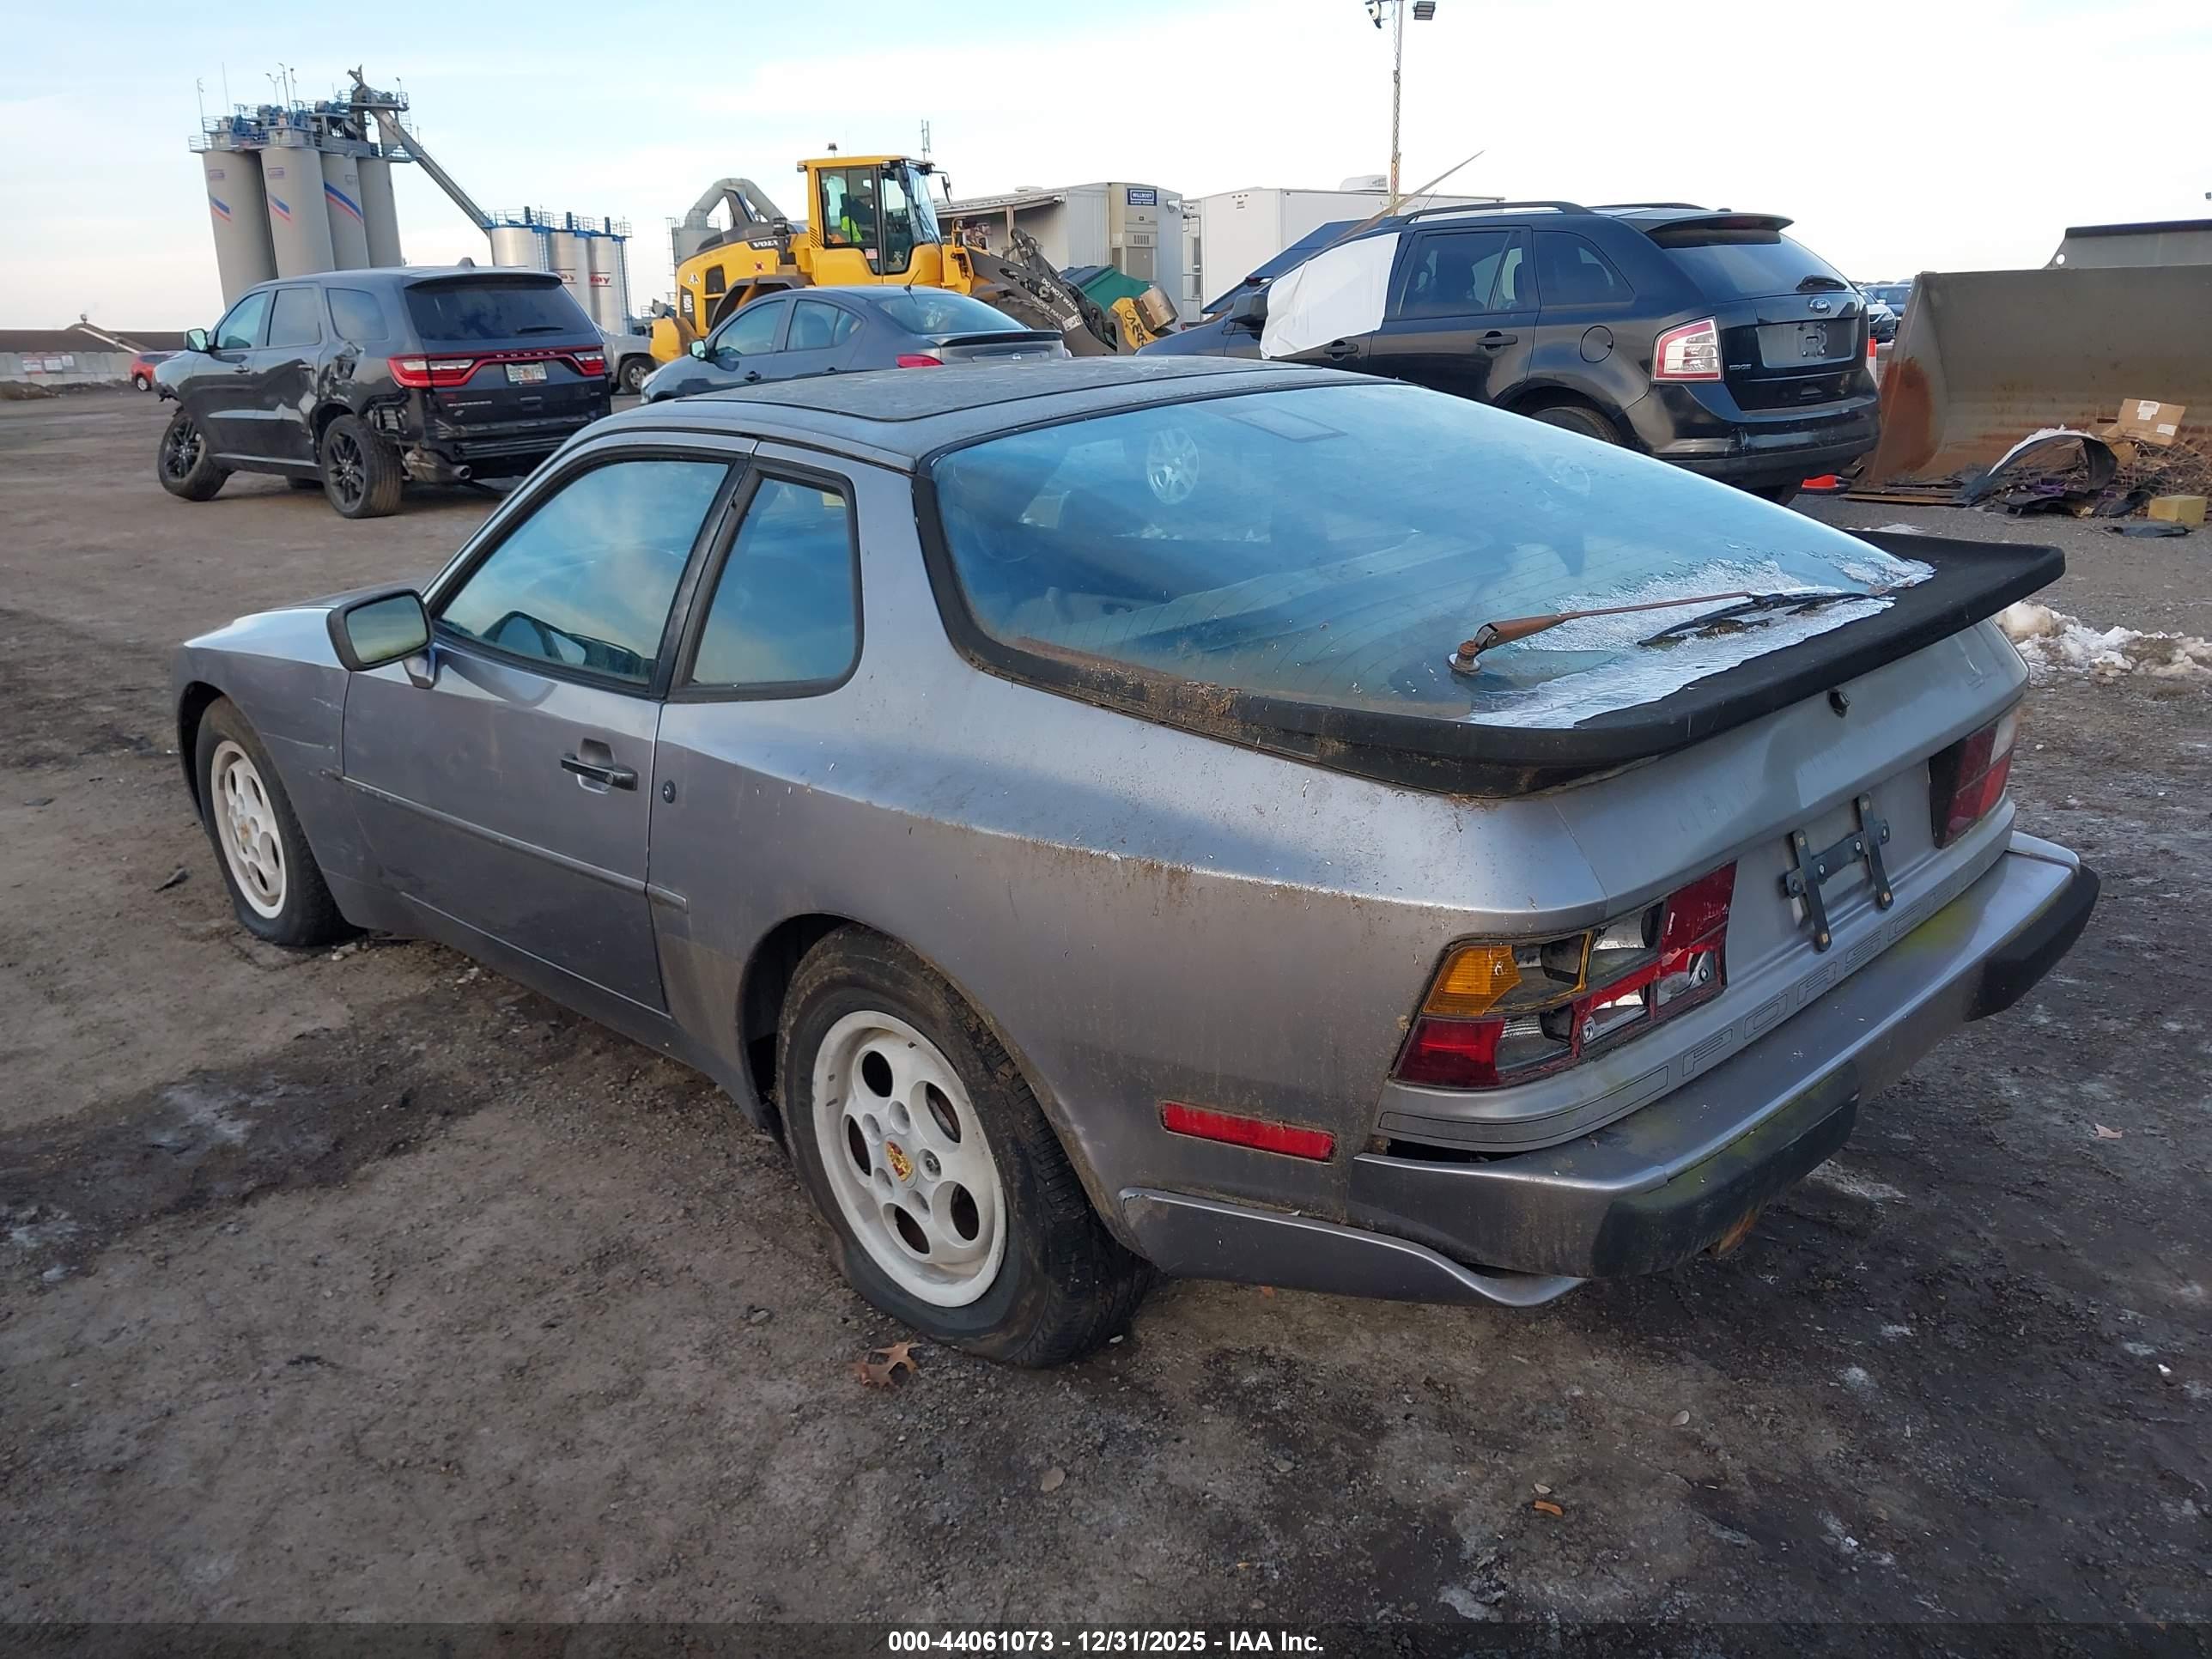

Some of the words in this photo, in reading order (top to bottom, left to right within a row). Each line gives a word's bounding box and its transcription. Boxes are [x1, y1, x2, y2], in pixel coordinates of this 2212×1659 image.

[1030, 295, 1051, 312] UNDER
[1049, 307, 1066, 322] MAST
[1041, 277, 1052, 289] DO
[1050, 286, 1063, 302] NOT
[1062, 296, 1080, 314] WALK
